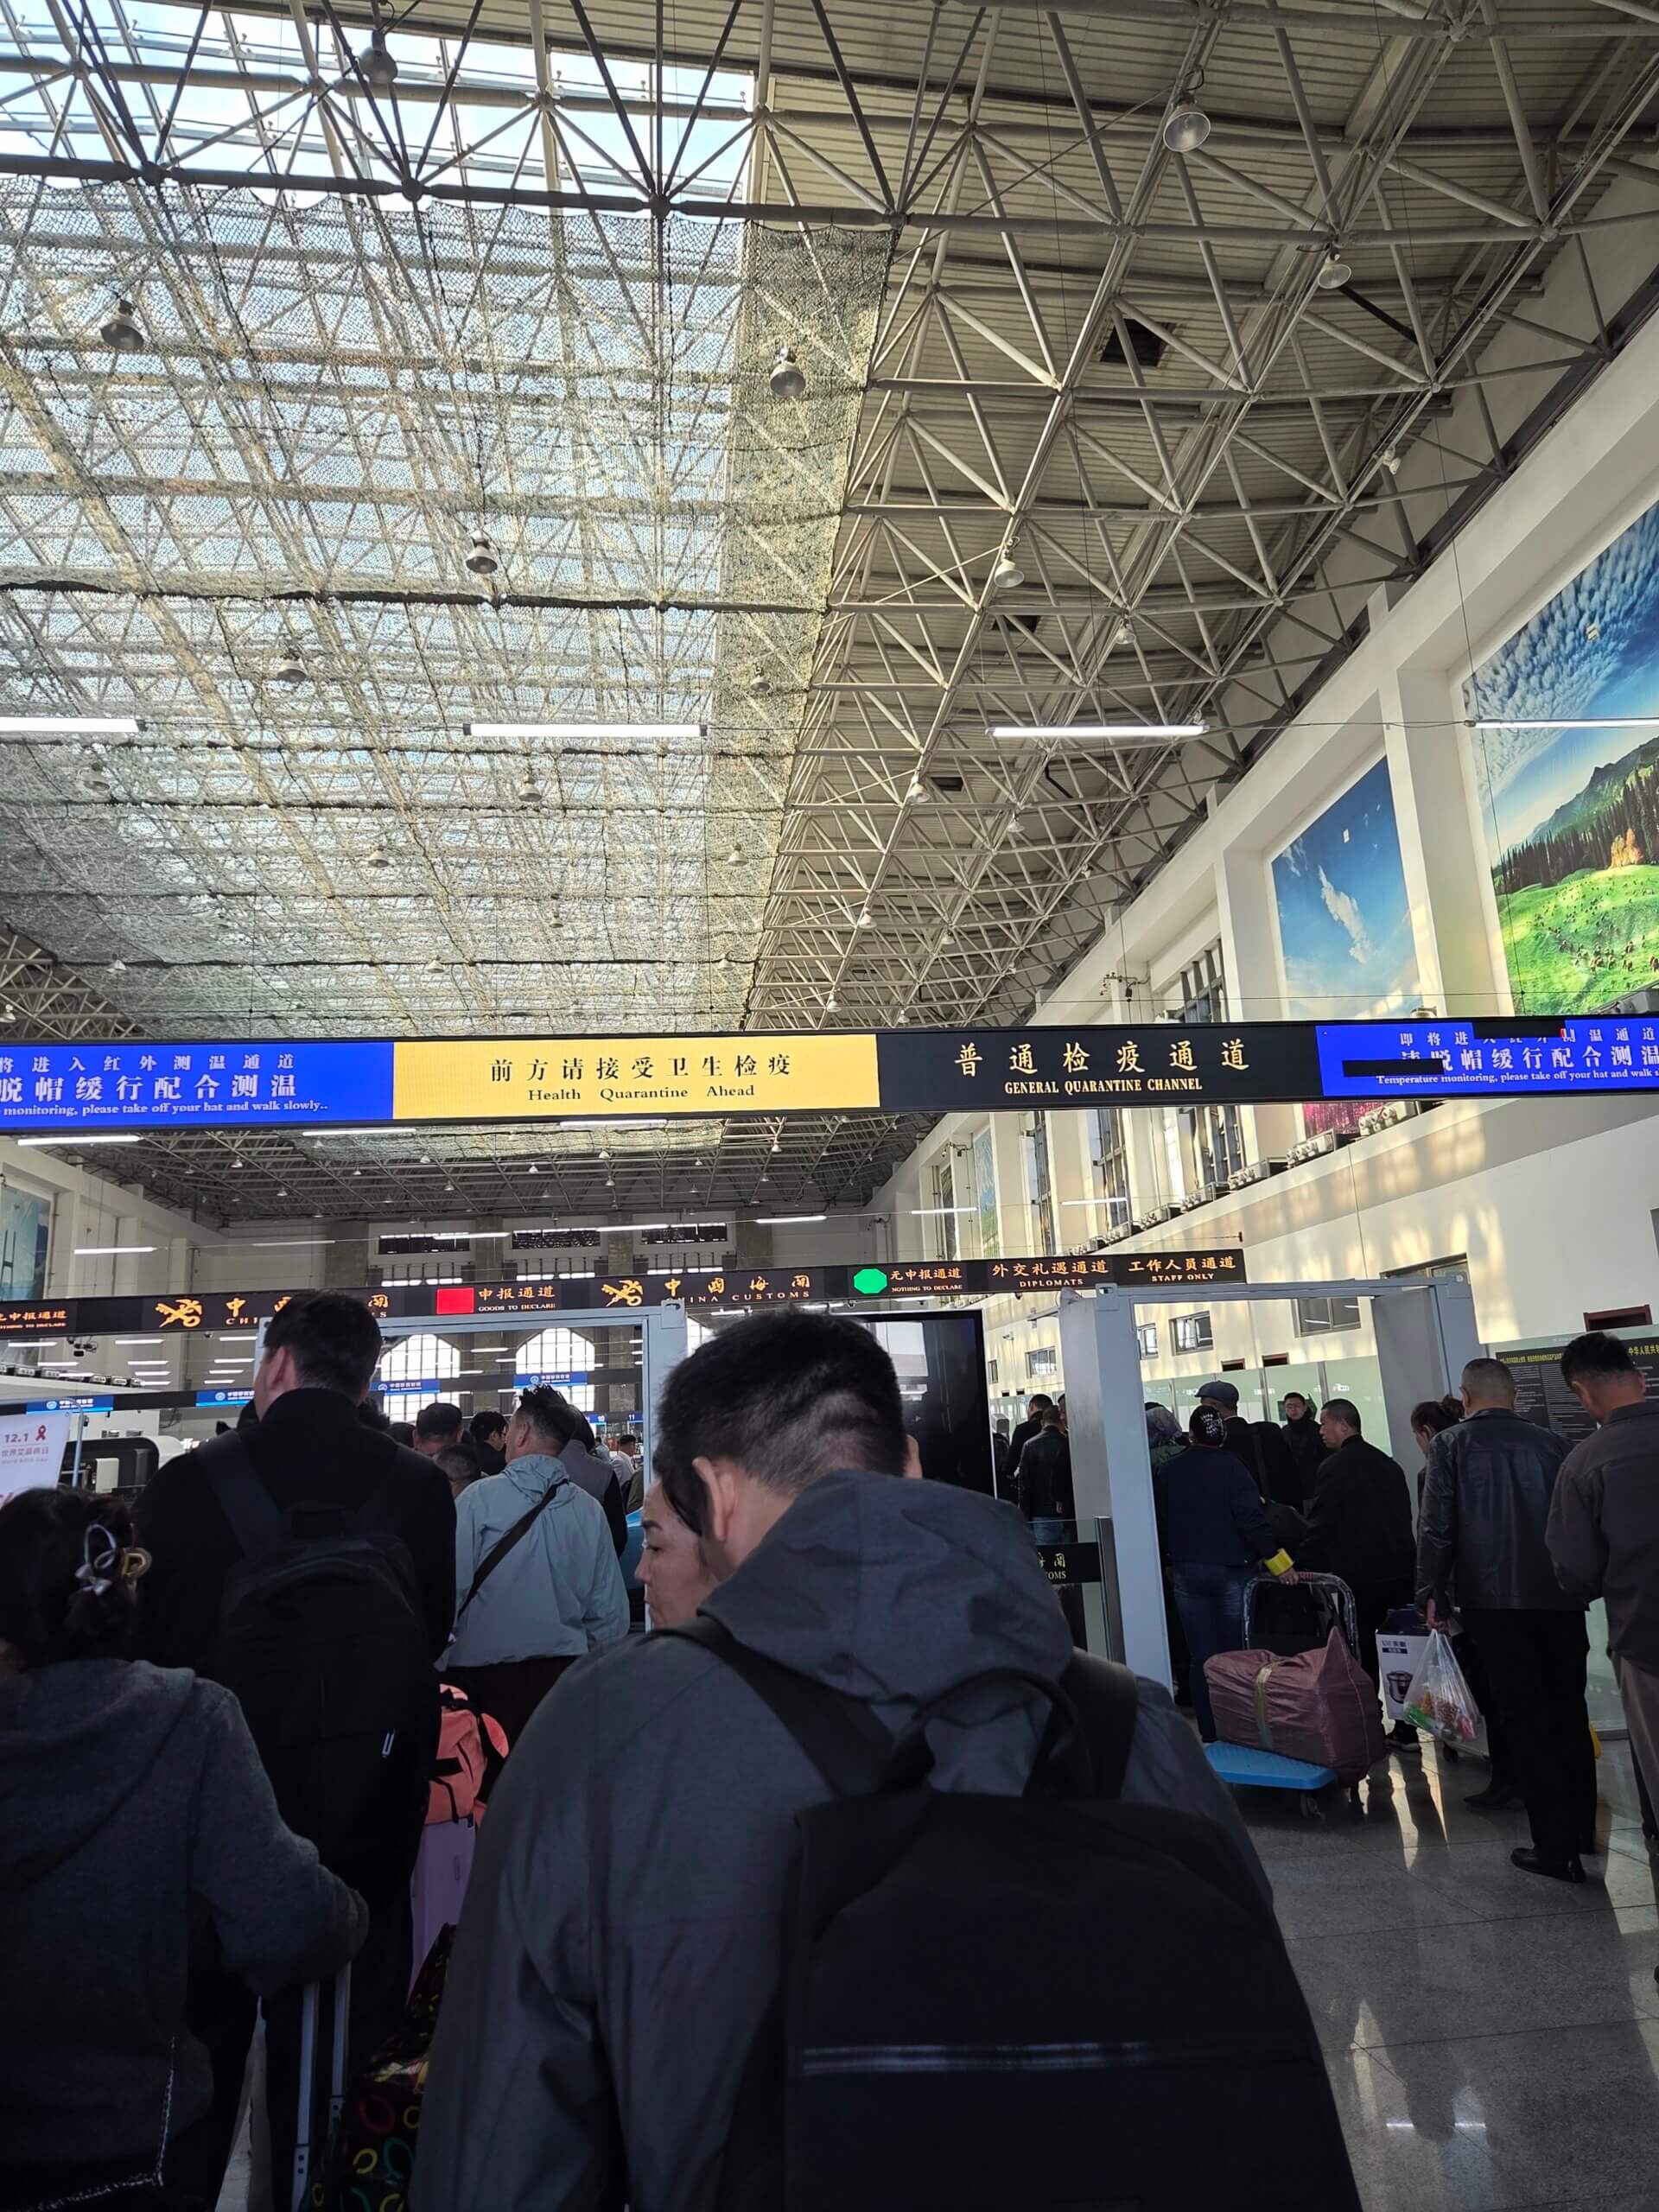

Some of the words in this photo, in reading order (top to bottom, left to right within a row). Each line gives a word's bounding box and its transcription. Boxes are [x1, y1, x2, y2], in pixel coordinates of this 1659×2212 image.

[0, 1053, 295, 1073] 将进入红外测温通道
[954, 1038, 1249, 1077] 普通检疫通道
[490, 1053, 791, 1082] 前方请接受卫生检疫
[1376, 1075, 1438, 1086] Temperature
[1441, 1073, 1497, 1084] monitoring,
[1501, 1072, 1529, 1083] please
[1531, 1071, 1550, 1080] take
[1554, 1070, 1567, 1079] off
[1569, 1071, 1592, 1081] your
[1593, 1070, 1608, 1078] hat
[1611, 1069, 1628, 1077] and
[1630, 1068, 1652, 1077] walk
[0, 1074, 296, 1103] 脱帽缓行配合测温
[528, 1088, 582, 1101] Health
[600, 1086, 689, 1103] Quarantine
[707, 1085, 754, 1097] Ahead
[1004, 1081, 1059, 1094] GENERAL
[1065, 1079, 1142, 1096] QUARANTINE
[1147, 1078, 1203, 1091] CHANNEL
[3, 1104, 79, 1116] monitoring,
[82, 1103, 119, 1116] please
[123, 1103, 148, 1113] take
[151, 1103, 171, 1113] off
[172, 1103, 200, 1114] your
[204, 1102, 223, 1111] hat
[226, 1102, 249, 1111] and
[251, 1100, 280, 1110] walk
[992, 1259, 1109, 1278] 外交礼遇通道
[1128, 1255, 1236, 1273] 工作人员通道
[891, 1267, 962, 1281] 无申报通道
[1020, 1278, 1084, 1287] DIPLOMATS
[478, 1285, 556, 1300] 申报通道
[732, 1291, 810, 1301] CUSTOMS
[4, 1433, 29, 1443] 12.1
